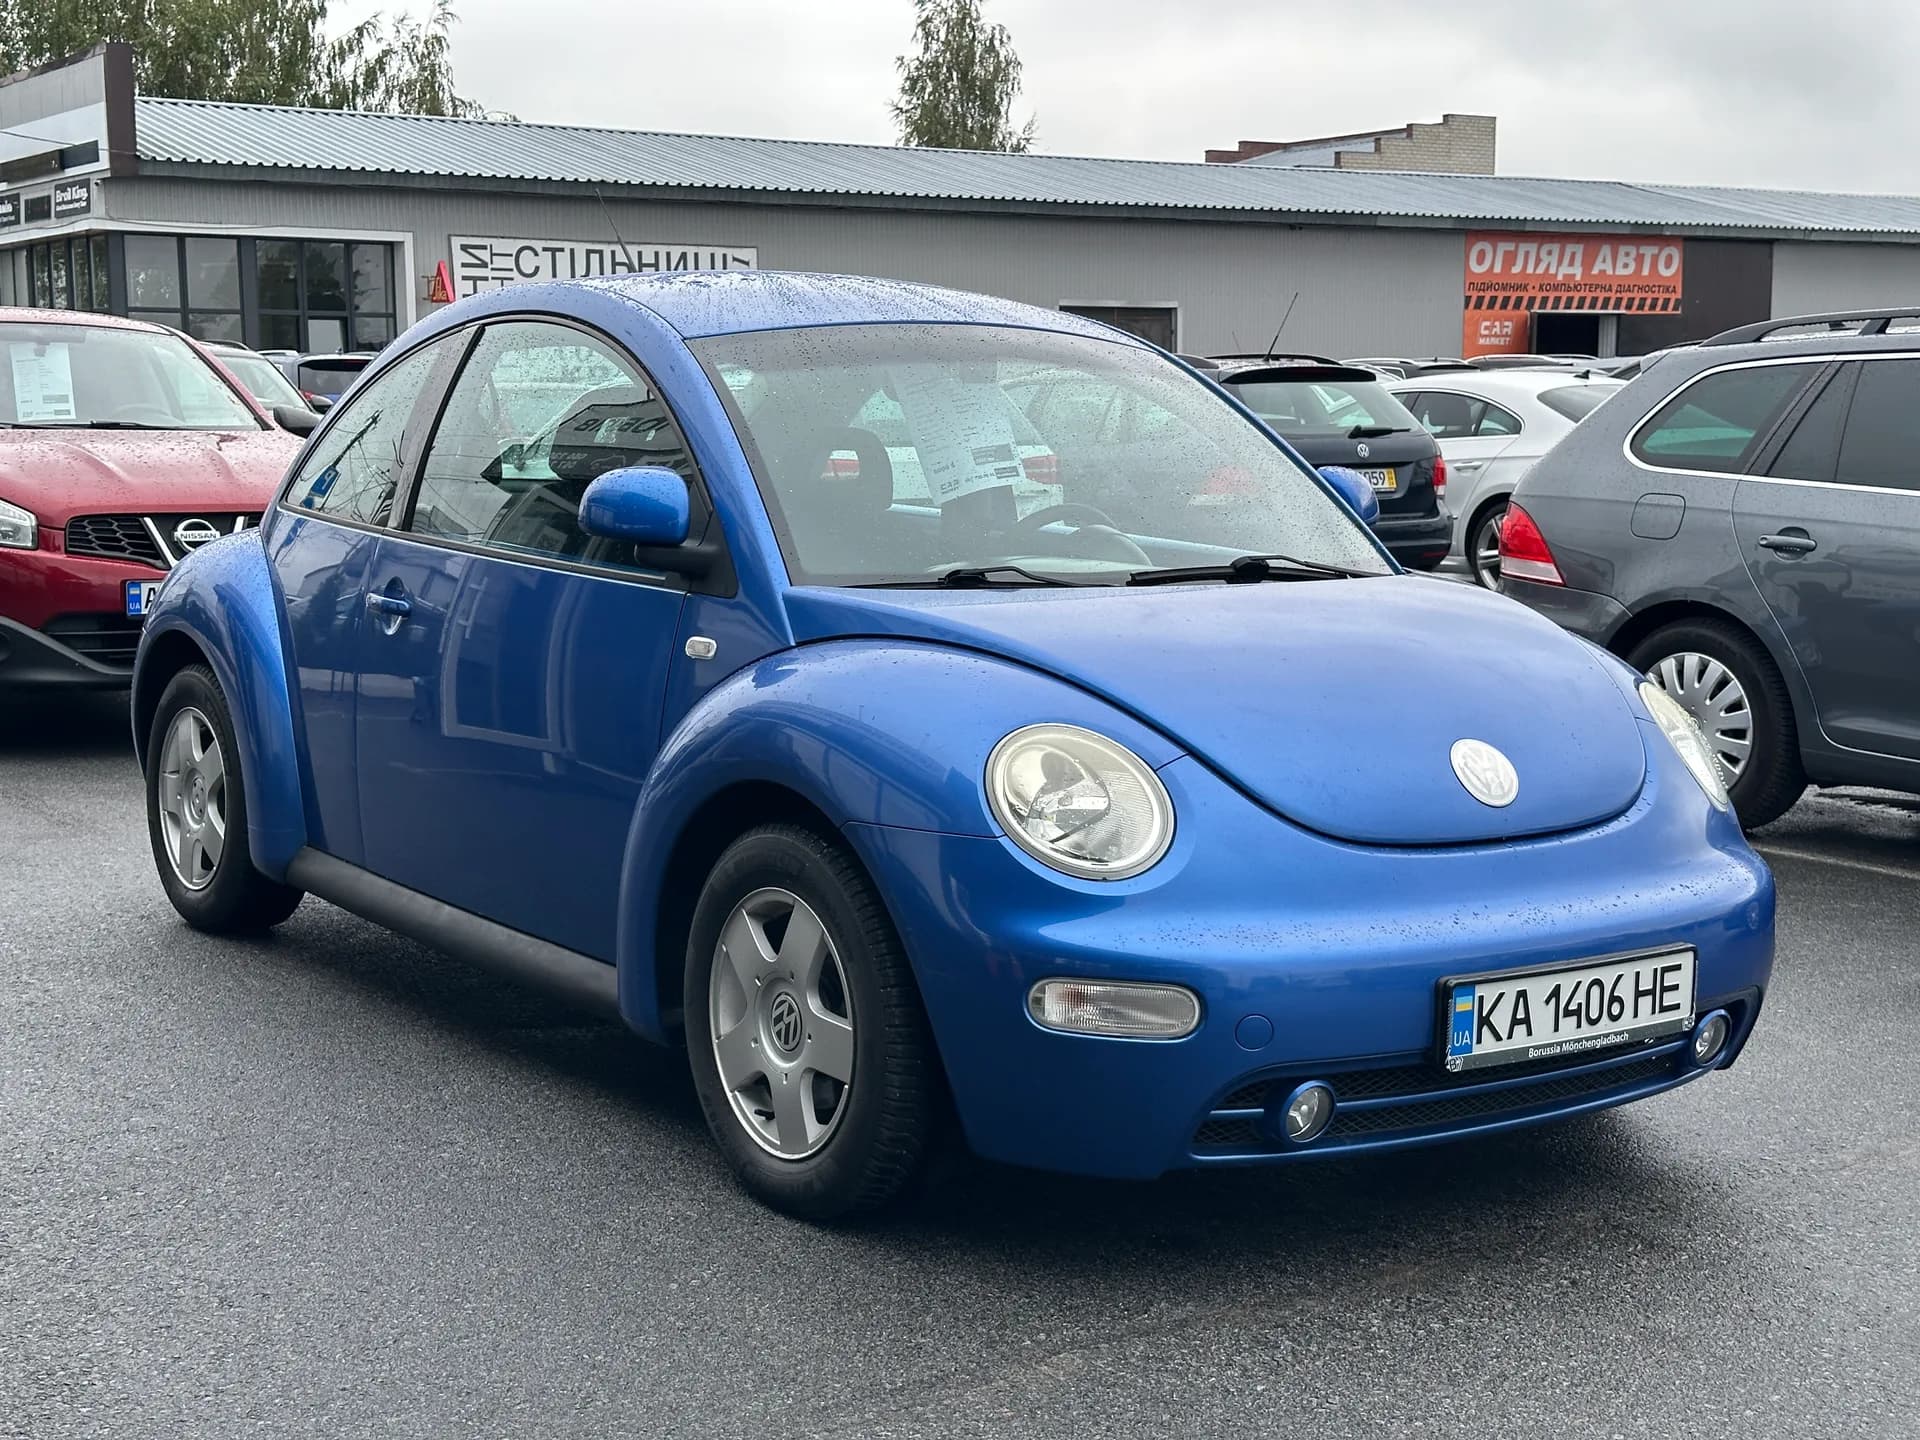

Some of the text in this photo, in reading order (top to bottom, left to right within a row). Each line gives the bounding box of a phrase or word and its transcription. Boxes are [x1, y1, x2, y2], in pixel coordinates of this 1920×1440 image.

[1469, 241, 1680, 280] ОГЛЯД АВТО
[1468, 281, 1677, 294] ПІДЙОМНИК КОМПЬЮТЕРНА ДІАГНОСТІКА
[1480, 320, 1513, 335] CAR
[180, 532, 217, 540] NISSAN
[129, 602, 141, 610] UA
[1475, 963, 1682, 1045] KA 1406 HE
[1453, 1029, 1472, 1048] UA
[1528, 1031, 1629, 1058] Borussia Mönchengladbach
